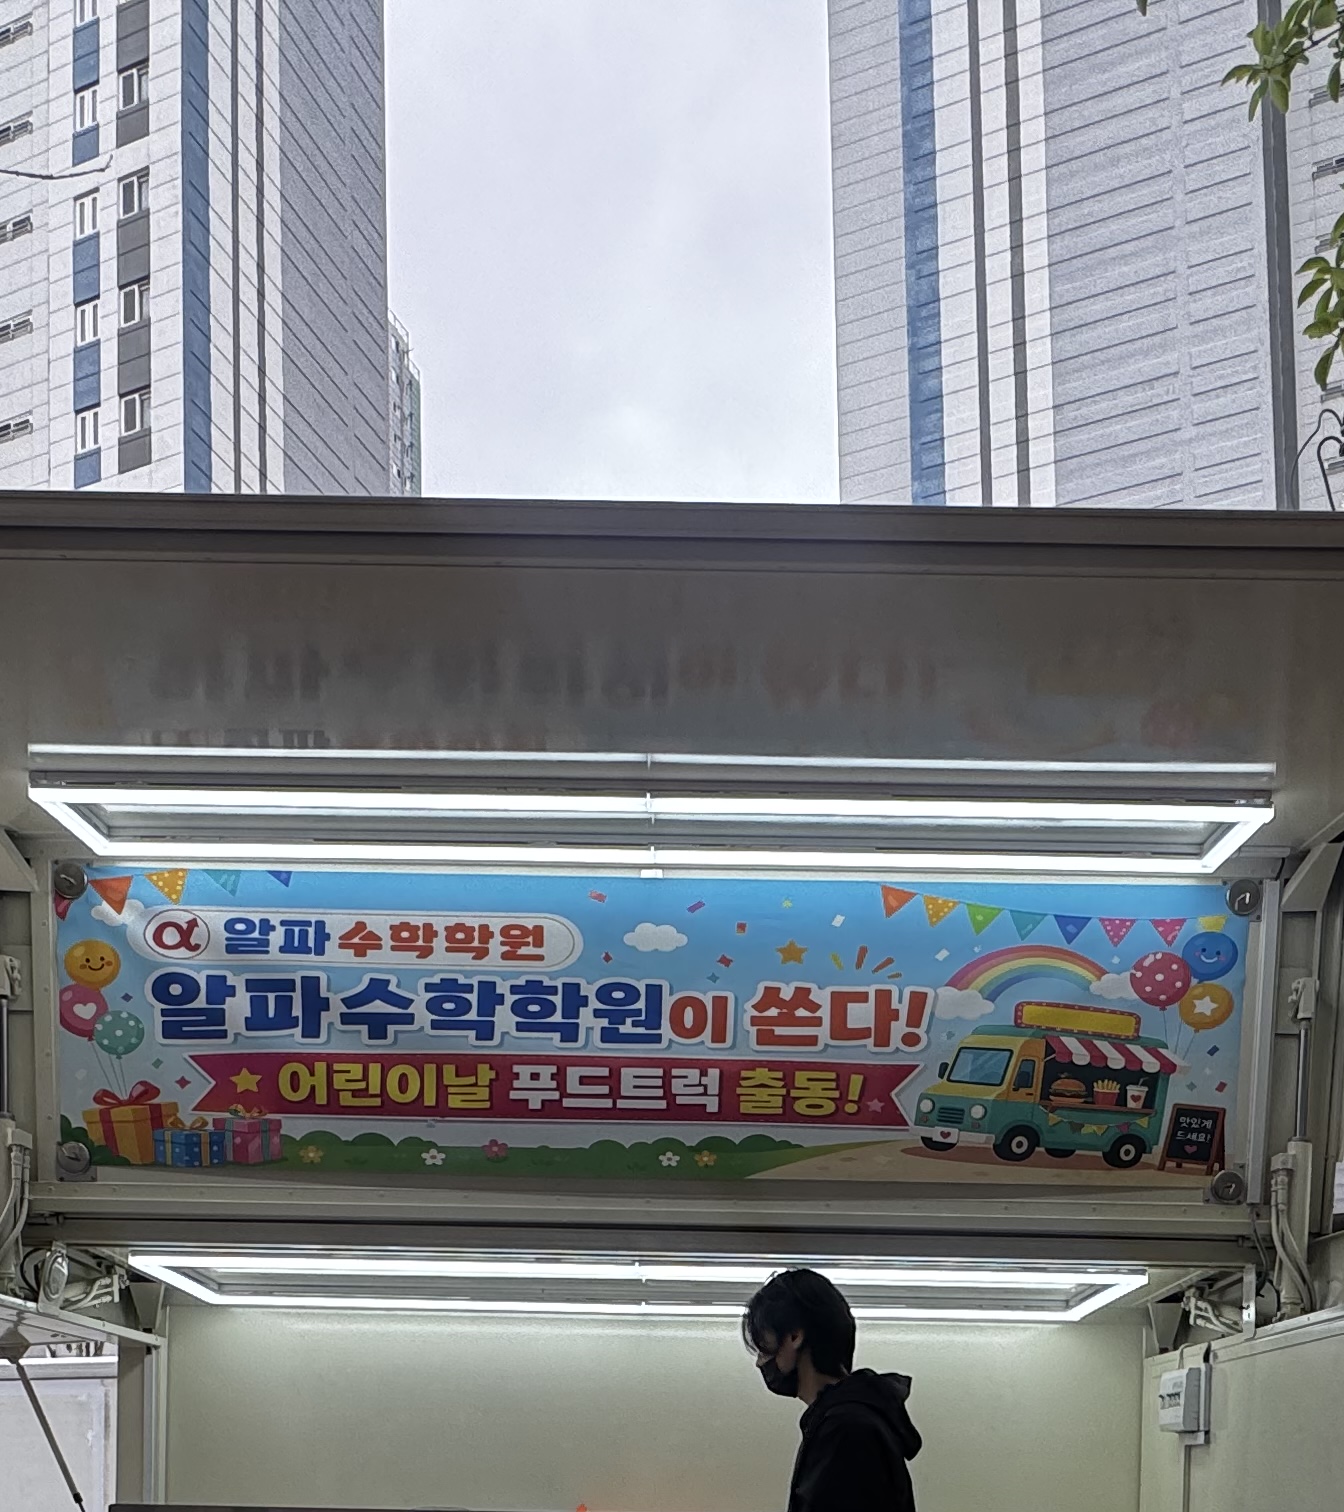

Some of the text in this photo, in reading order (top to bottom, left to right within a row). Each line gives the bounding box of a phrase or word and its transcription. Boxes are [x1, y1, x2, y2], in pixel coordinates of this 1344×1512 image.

[151, 971, 929, 1049] 알파수학학원이 쏜다!
[278, 1061, 864, 1116] 어린이날 푸드트럭 출동!
[1179, 1116, 1213, 1129] 맛있게
